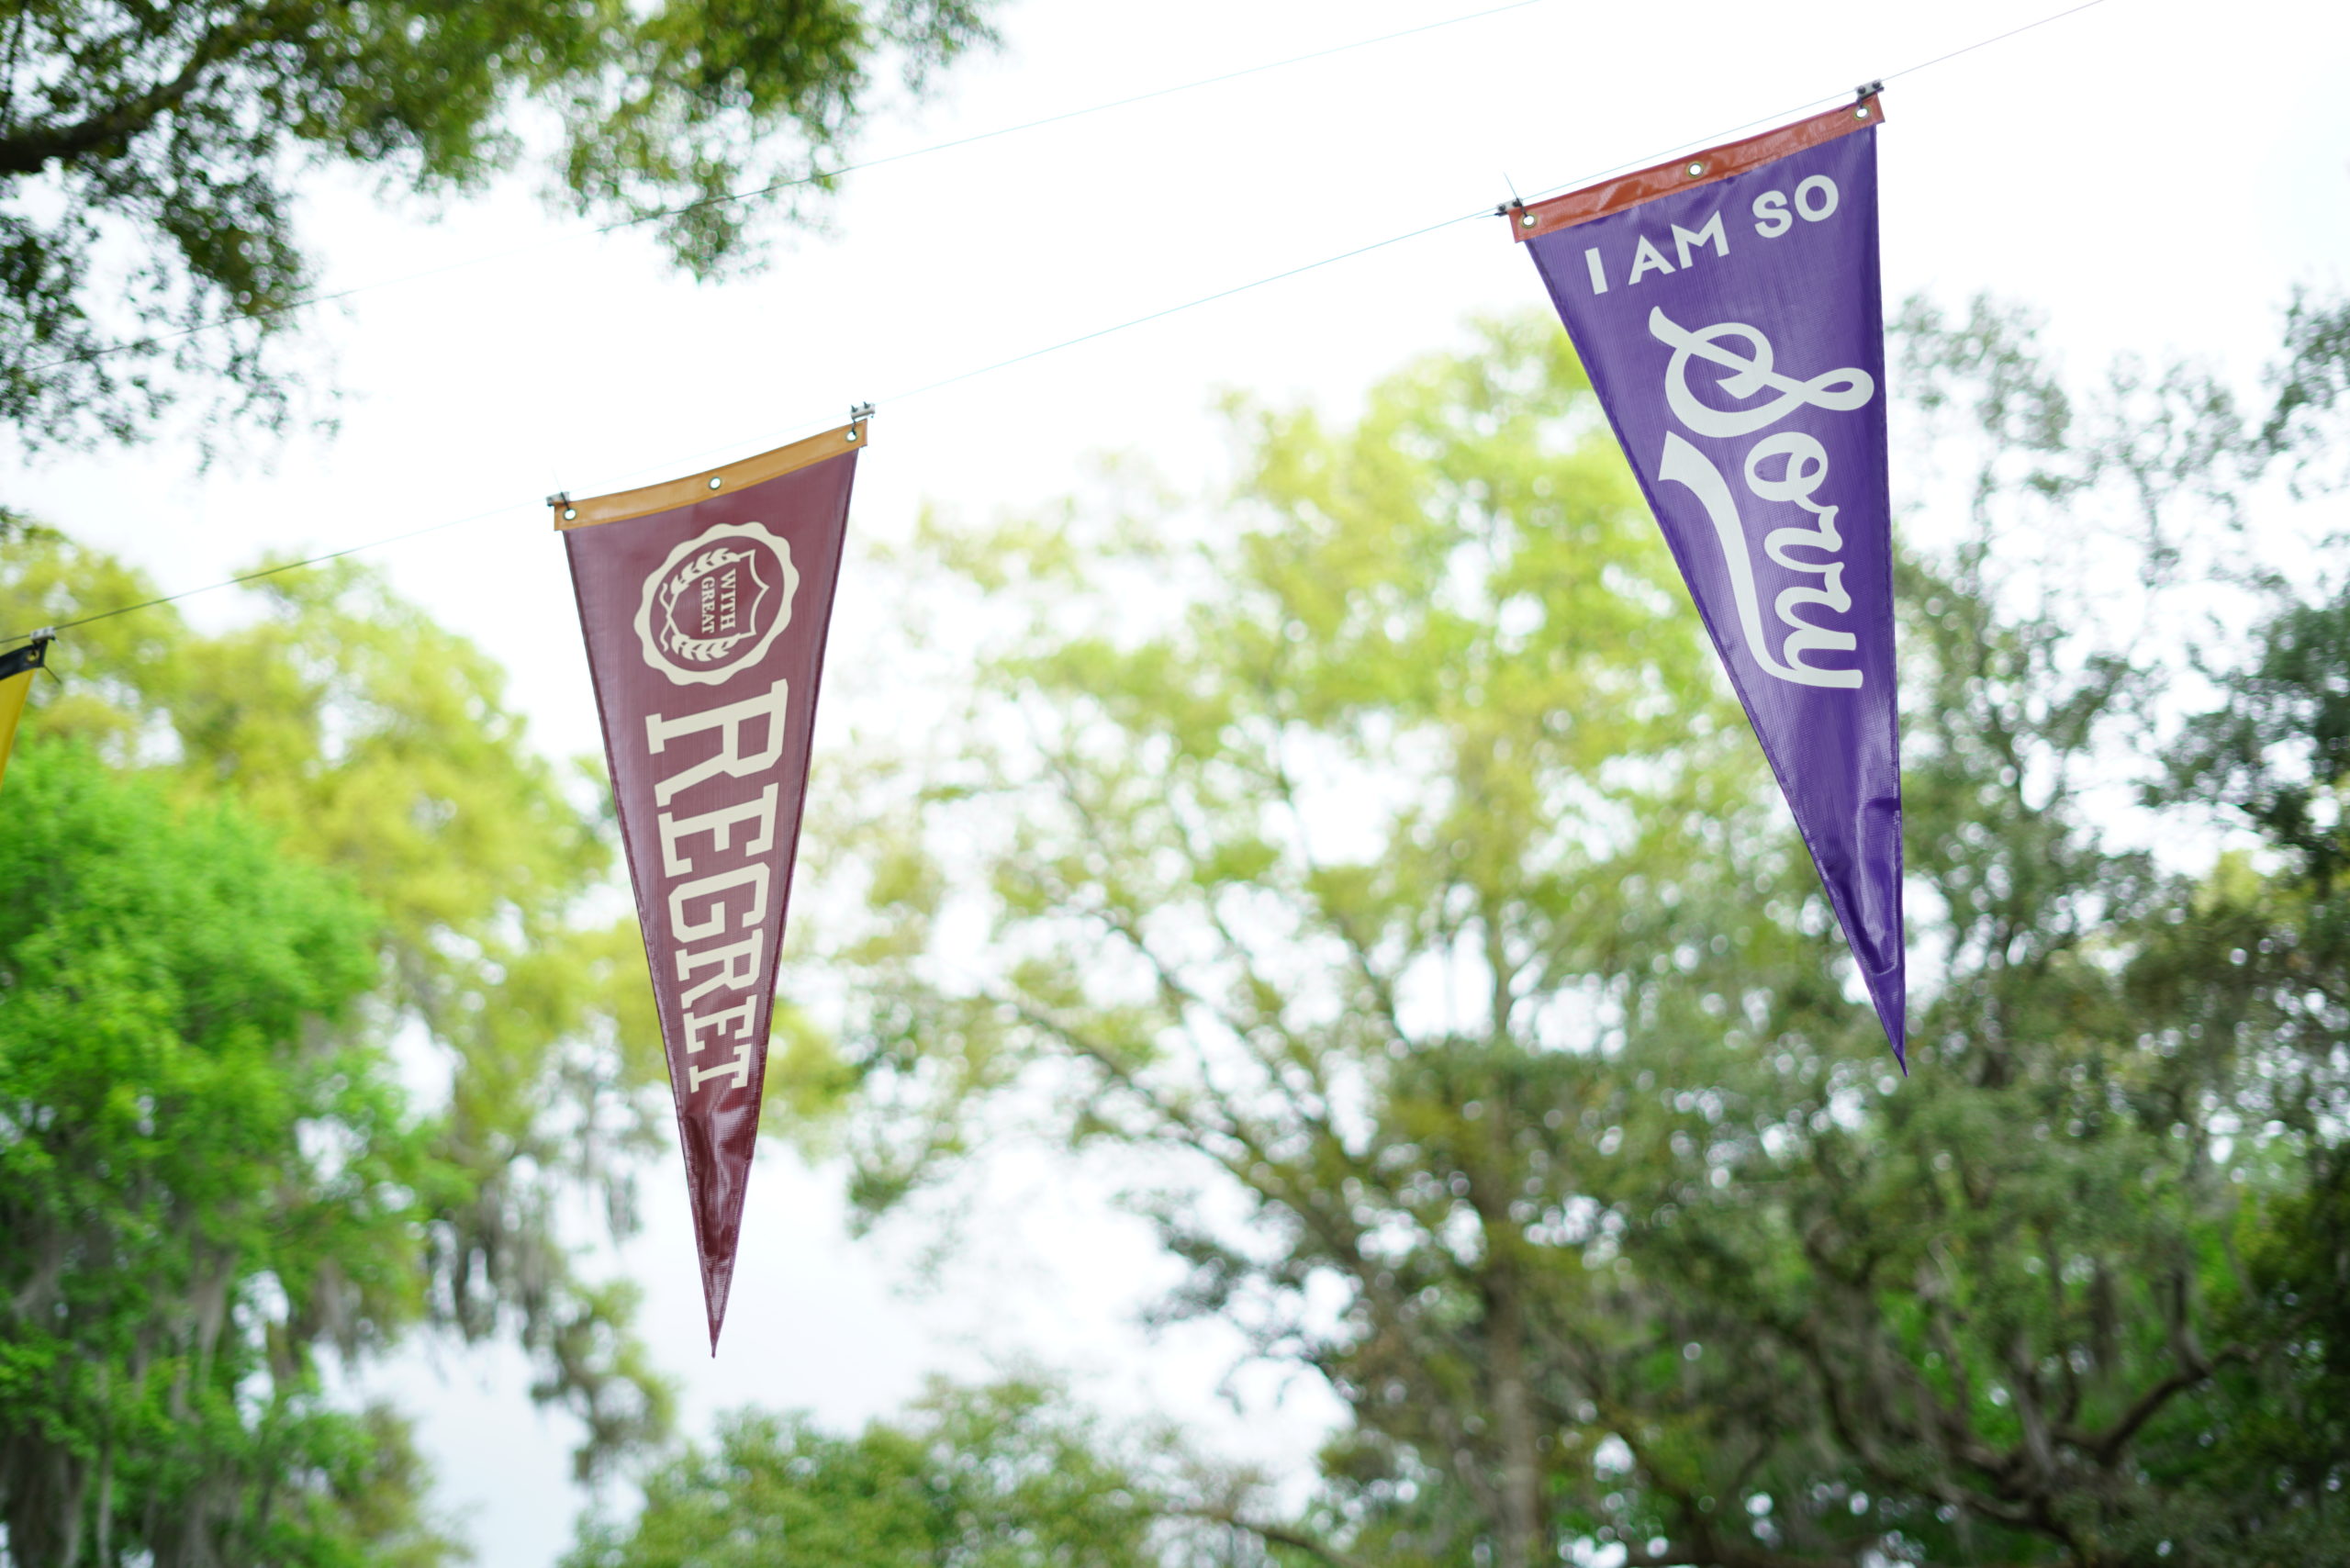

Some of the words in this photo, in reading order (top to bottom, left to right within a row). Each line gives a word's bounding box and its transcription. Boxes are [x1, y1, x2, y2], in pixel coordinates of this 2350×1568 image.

[1584, 247, 1608, 295] I
[1628, 210, 1730, 286] AM
[1751, 174, 1839, 239] SO
[1649, 306, 1874, 689] Sorry
[701, 577, 715, 633] GREAT
[721, 568, 736, 632] WITH
[645, 678, 789, 1093] REGRET
